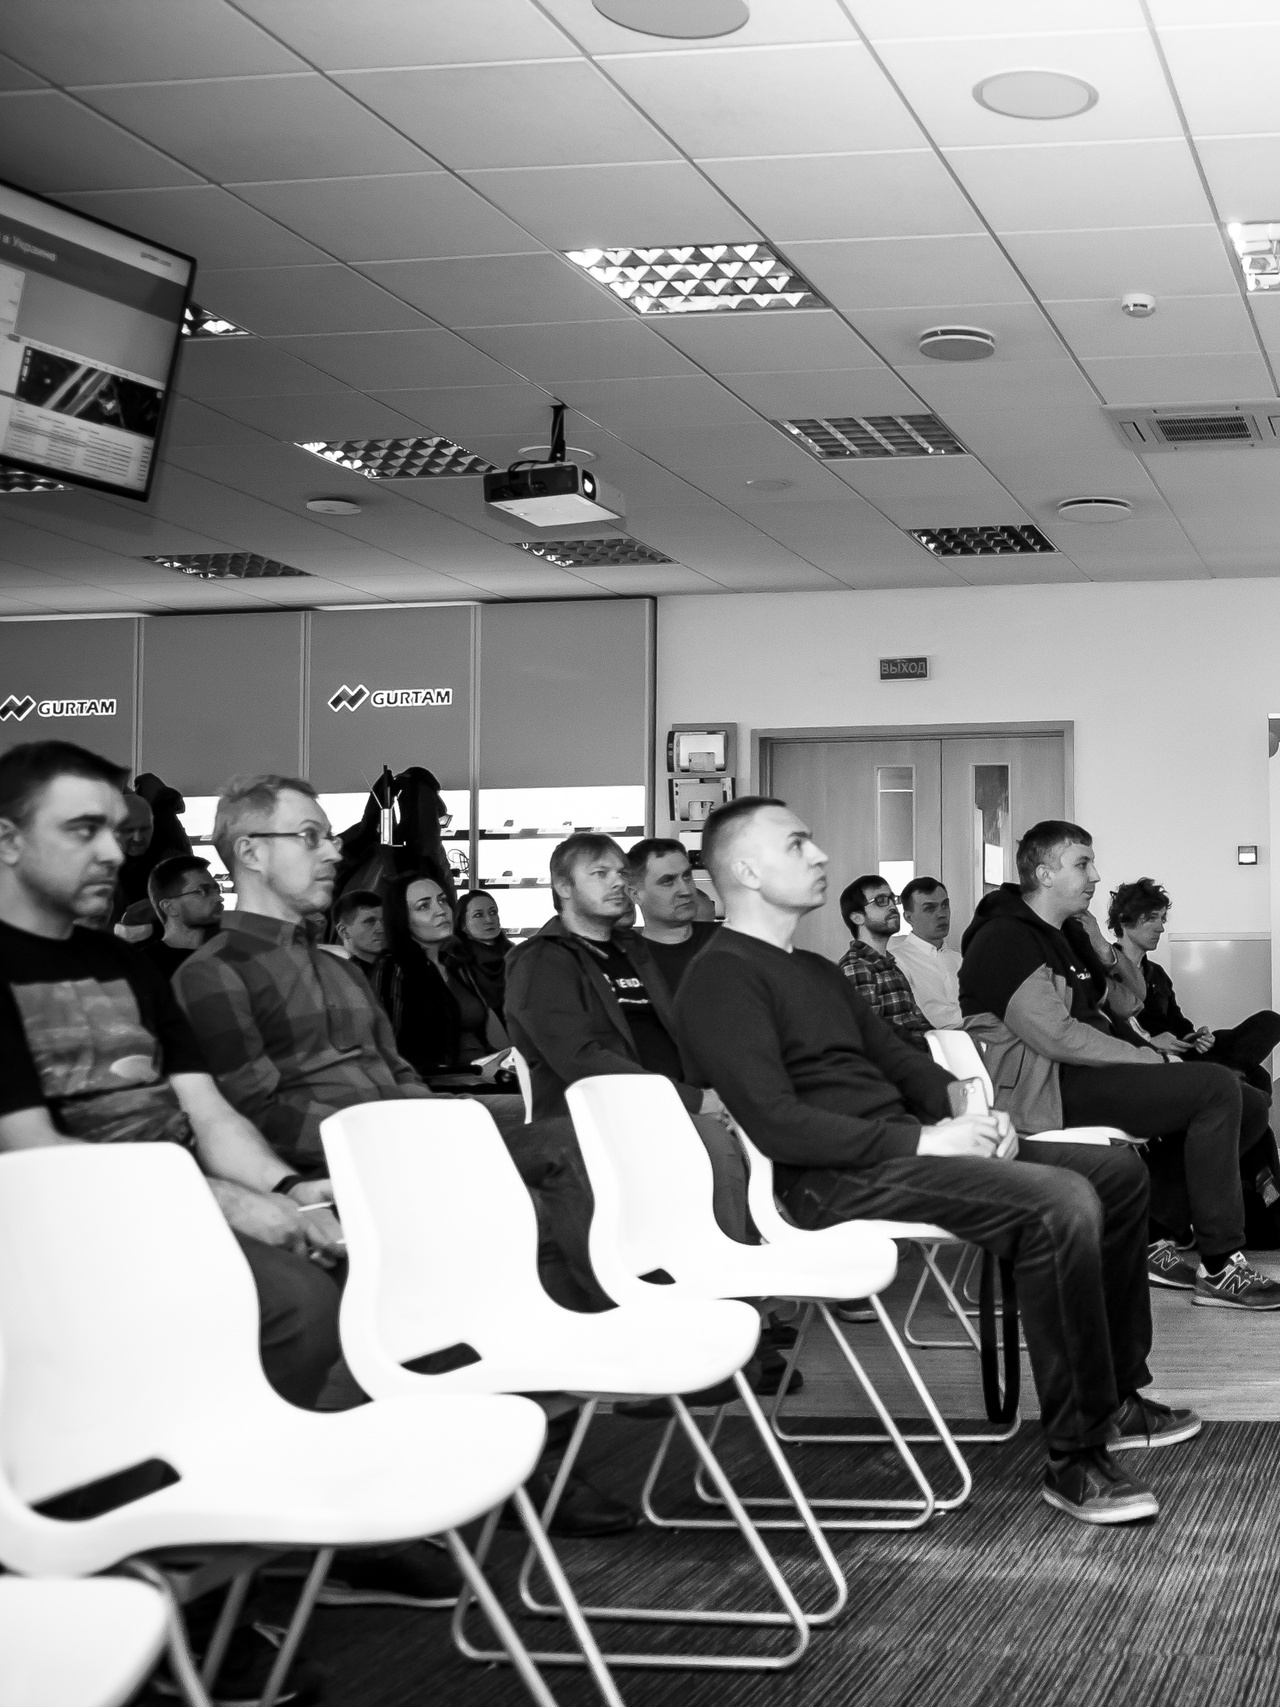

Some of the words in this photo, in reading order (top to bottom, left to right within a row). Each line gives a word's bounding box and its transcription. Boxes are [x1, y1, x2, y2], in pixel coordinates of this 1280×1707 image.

[881, 661, 927, 675] ВЫХОД
[371, 689, 452, 707] GURTAM
[38, 699, 116, 718] GURTAM
